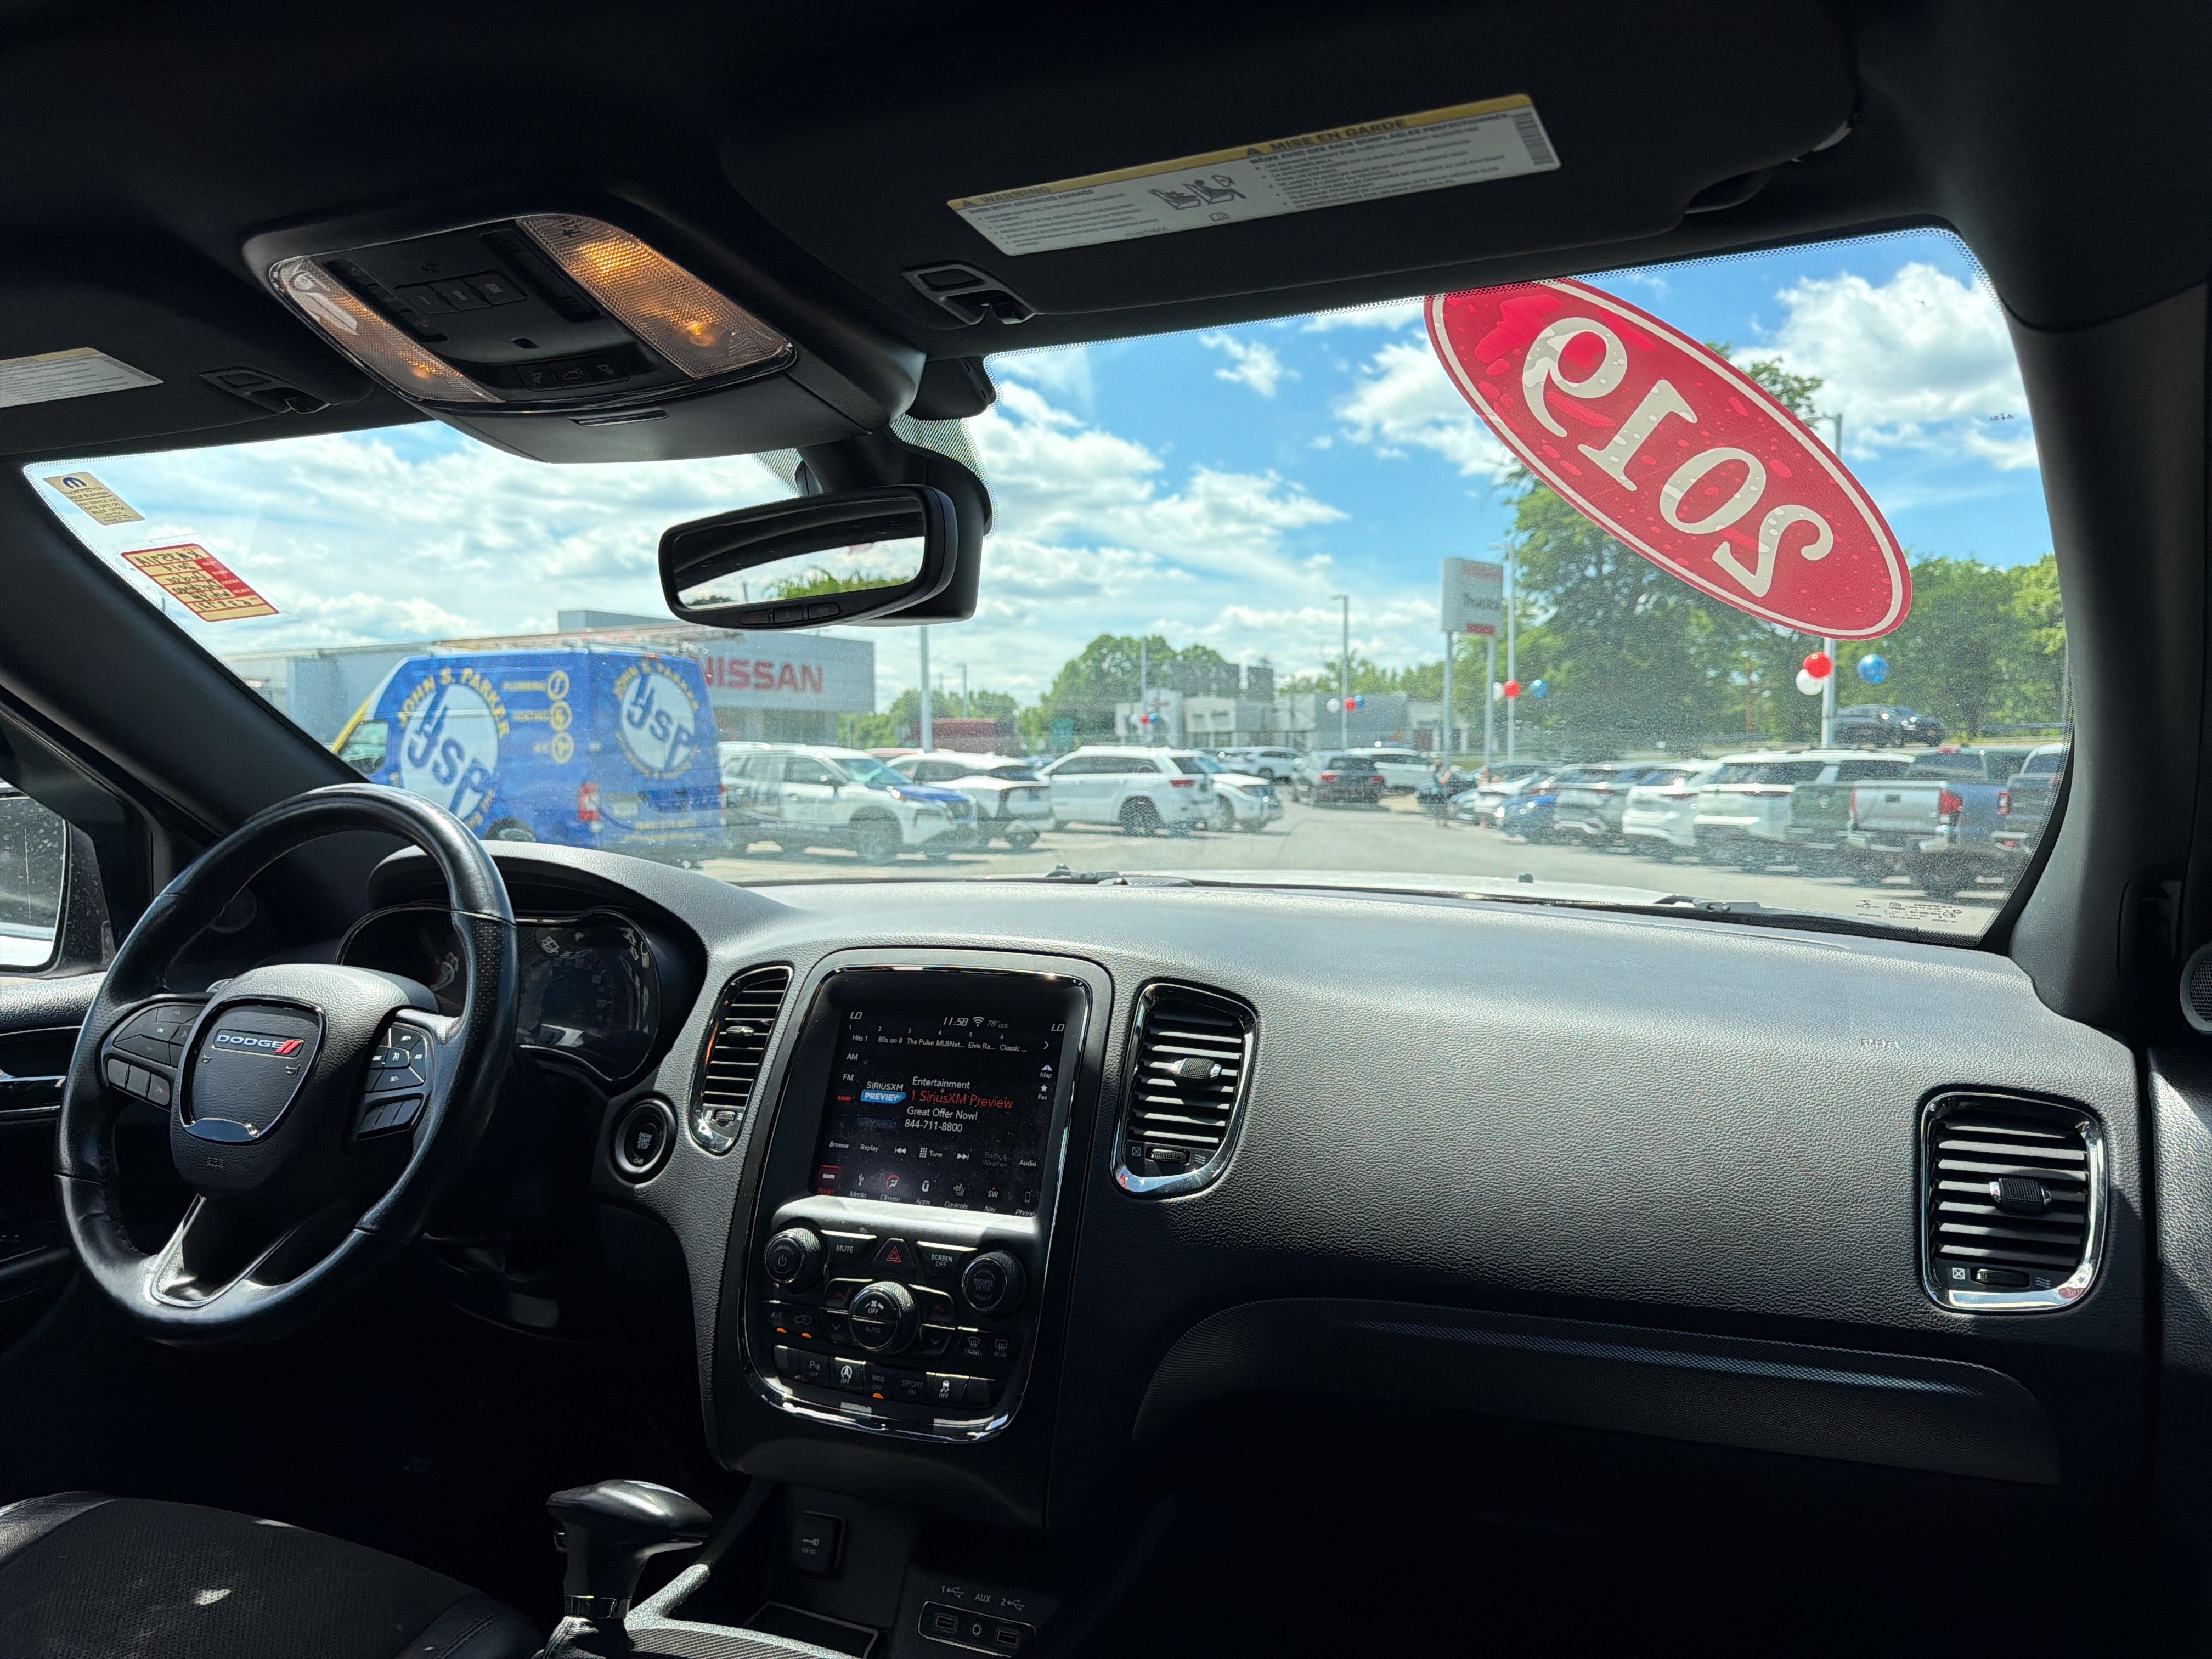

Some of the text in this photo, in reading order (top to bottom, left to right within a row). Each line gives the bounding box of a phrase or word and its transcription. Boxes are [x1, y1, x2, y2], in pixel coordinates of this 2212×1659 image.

[1268, 119, 1404, 151] MISE EN GARDE
[398, 675, 436, 729] JOHN
[943, 1017, 969, 1026] 11:58
[1051, 1023, 1064, 1032] LO
[216, 1035, 284, 1049] DODGE
[843, 1073, 854, 1081] FM
[866, 1081, 904, 1091] SIRIUSXM
[912, 1076, 971, 1090] Entertainment
[864, 1092, 901, 1102] PREVIEW
[911, 1090, 1014, 1109] 1 SiriusXM Preview
[907, 1106, 978, 1121] Great Offer Now!
[904, 1119, 963, 1133] 844-711-8800
[830, 1141, 849, 1149] Browse
[860, 1143, 879, 1153] Replay
[929, 1150, 943, 1158] Tune
[1019, 1159, 1037, 1167] Audio
[1015, 1209, 1035, 1217] Phone
[836, 1244, 854, 1254] MUTE
[930, 1254, 953, 1263] SCREEN
[935, 1260, 947, 1268] OFF
[867, 1306, 879, 1314] OFF
[865, 1325, 881, 1334] AUTO
[901, 1379, 924, 1389] SPORT
[974, 1593, 991, 1604] AUX
